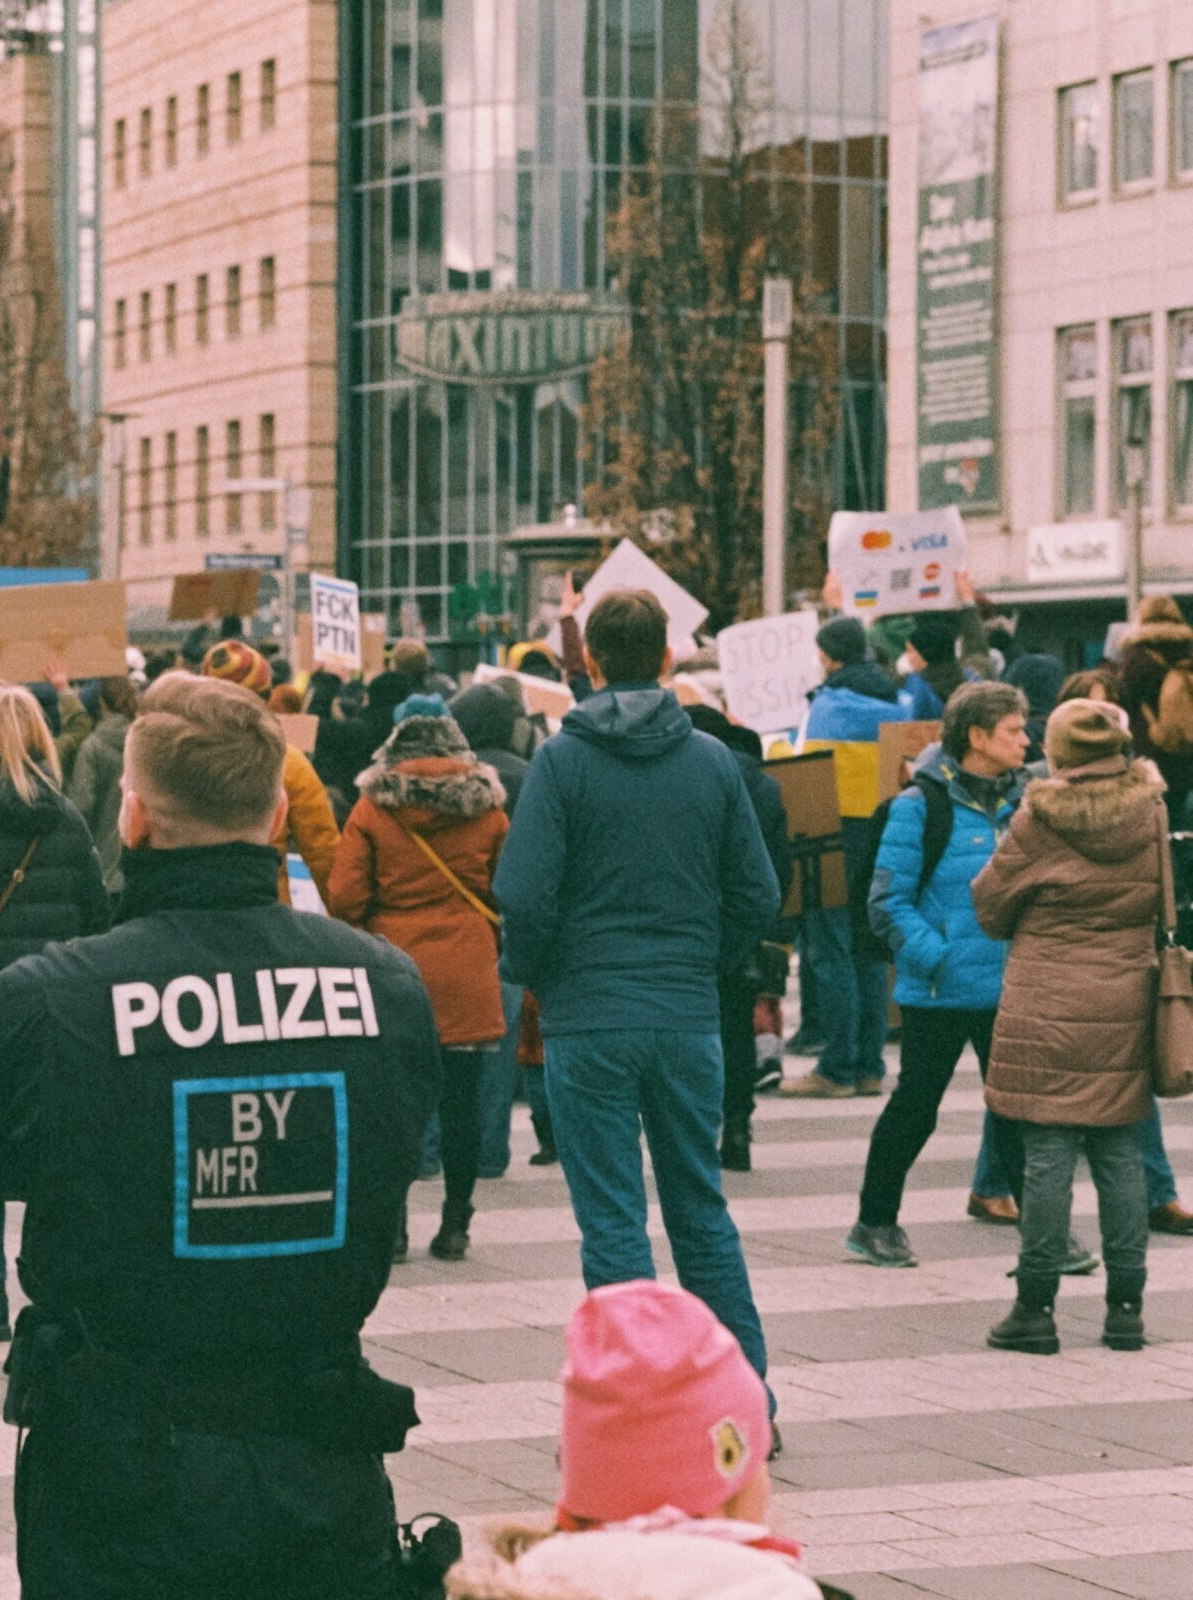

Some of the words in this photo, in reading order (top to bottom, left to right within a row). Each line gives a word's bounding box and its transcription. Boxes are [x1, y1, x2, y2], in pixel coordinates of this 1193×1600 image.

[316, 590, 355, 624] FCK
[317, 623, 356, 655] PTN
[725, 622, 804, 675] STOP
[111, 966, 380, 1057] POLIZEI
[231, 1089, 296, 1143] BY
[195, 1145, 259, 1195] MFR
